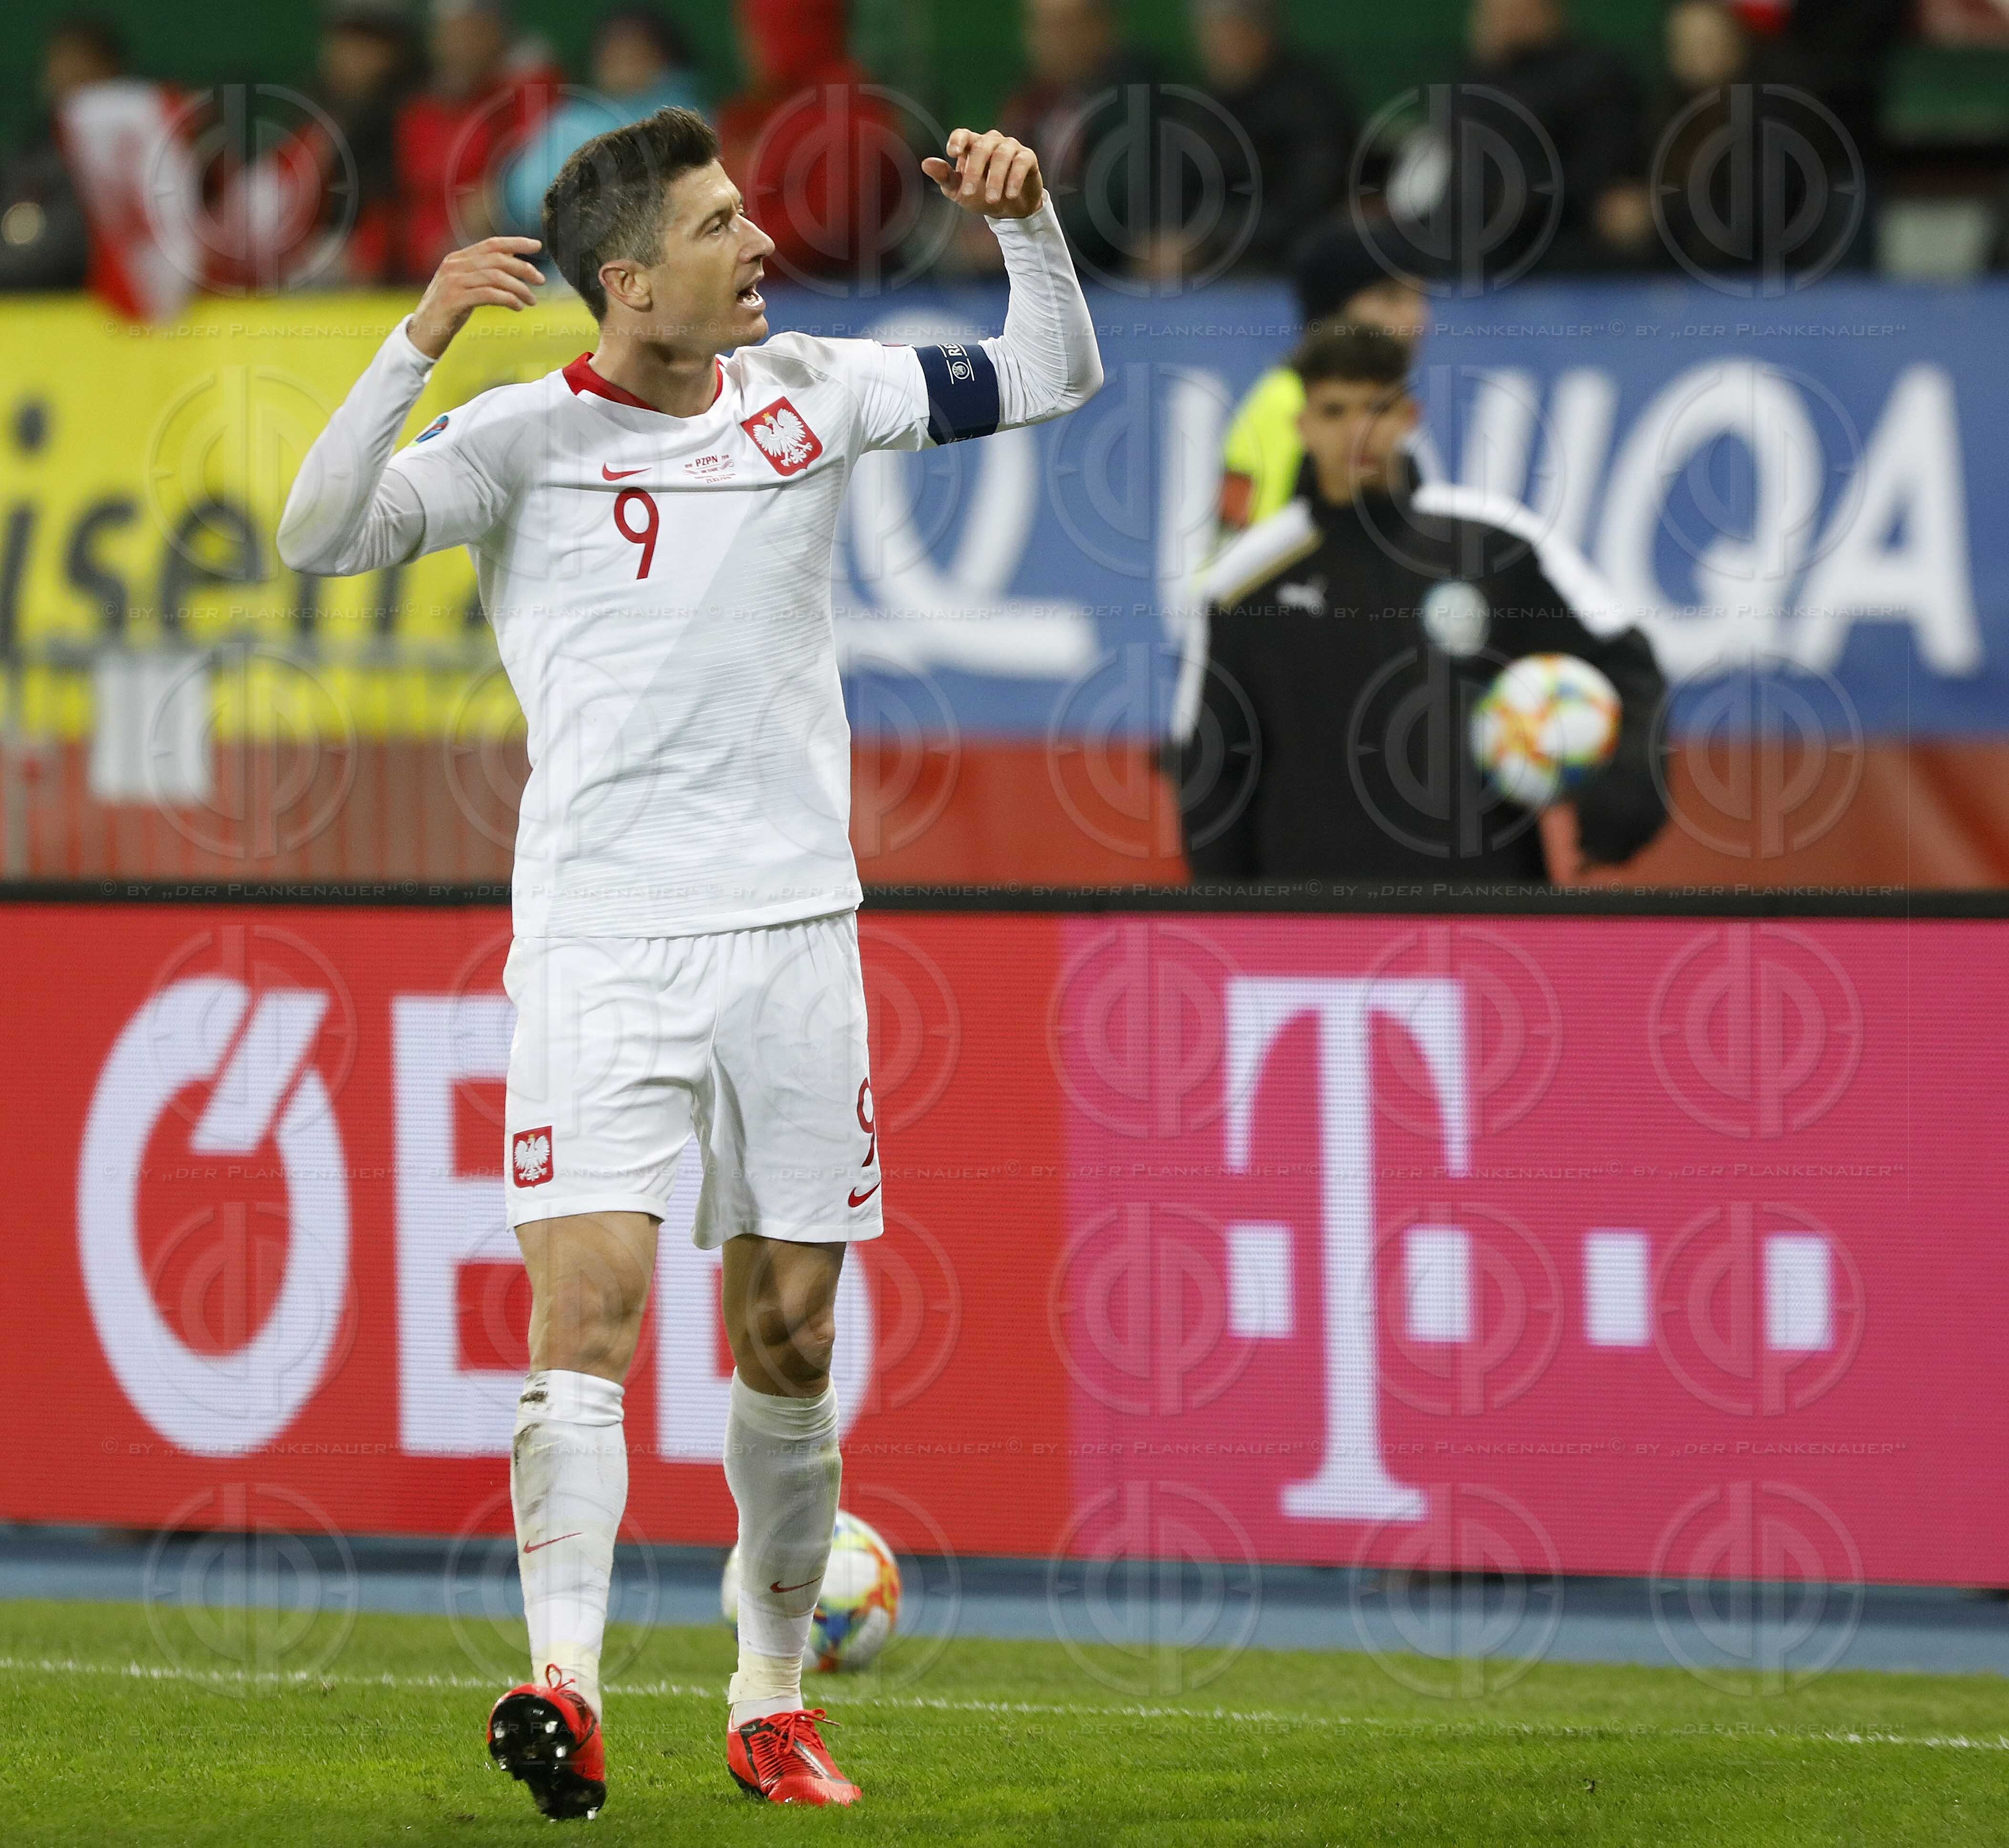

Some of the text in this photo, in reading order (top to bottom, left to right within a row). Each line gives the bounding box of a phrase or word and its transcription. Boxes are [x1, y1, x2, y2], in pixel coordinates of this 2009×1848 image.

[695, 455, 718, 467] PZPN
[614, 487, 659, 580] 9
[857, 1077, 875, 1168] 9
